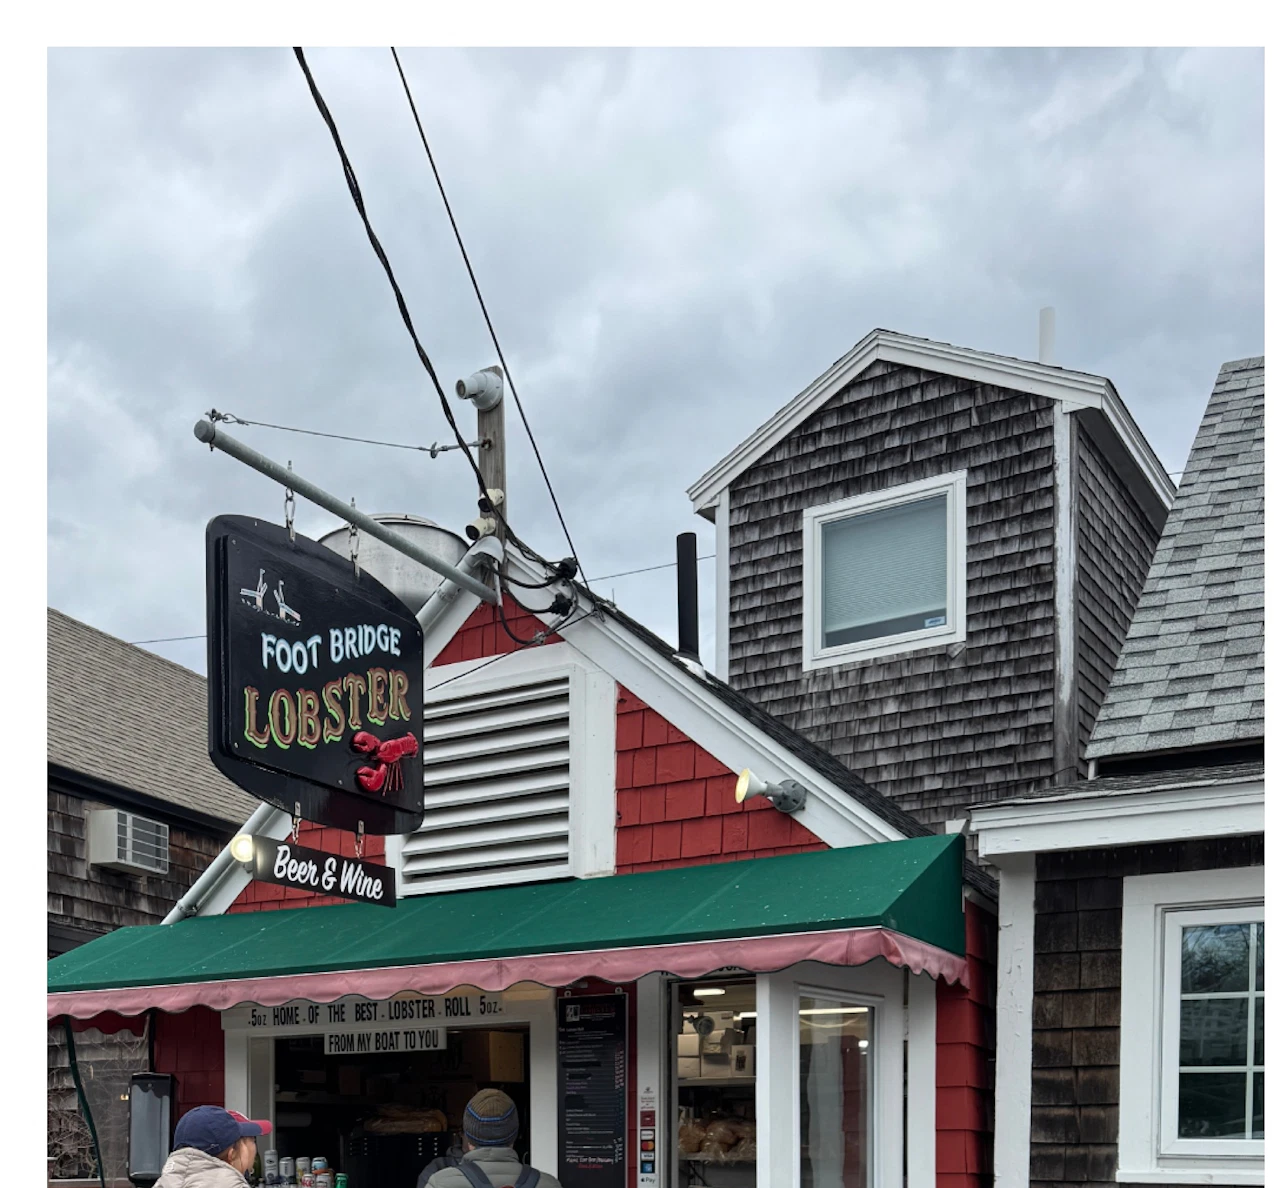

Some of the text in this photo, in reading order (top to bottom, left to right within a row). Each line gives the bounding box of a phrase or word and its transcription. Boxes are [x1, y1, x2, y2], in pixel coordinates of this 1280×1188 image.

[261, 624, 401, 675] FOOT BRIDGE
[243, 667, 412, 750] LOBSTER
[273, 844, 384, 900] Beer & Wine
[272, 1005, 299, 1026] HOME
[308, 1004, 320, 1023] OF
[327, 1003, 345, 1023] THE
[355, 1001, 378, 1022] BEST
[388, 999, 435, 1020] LOBSTER
[445, 996, 471, 1017] ROLL
[328, 1029, 439, 1052] FROM MY BOAT TO YOU
